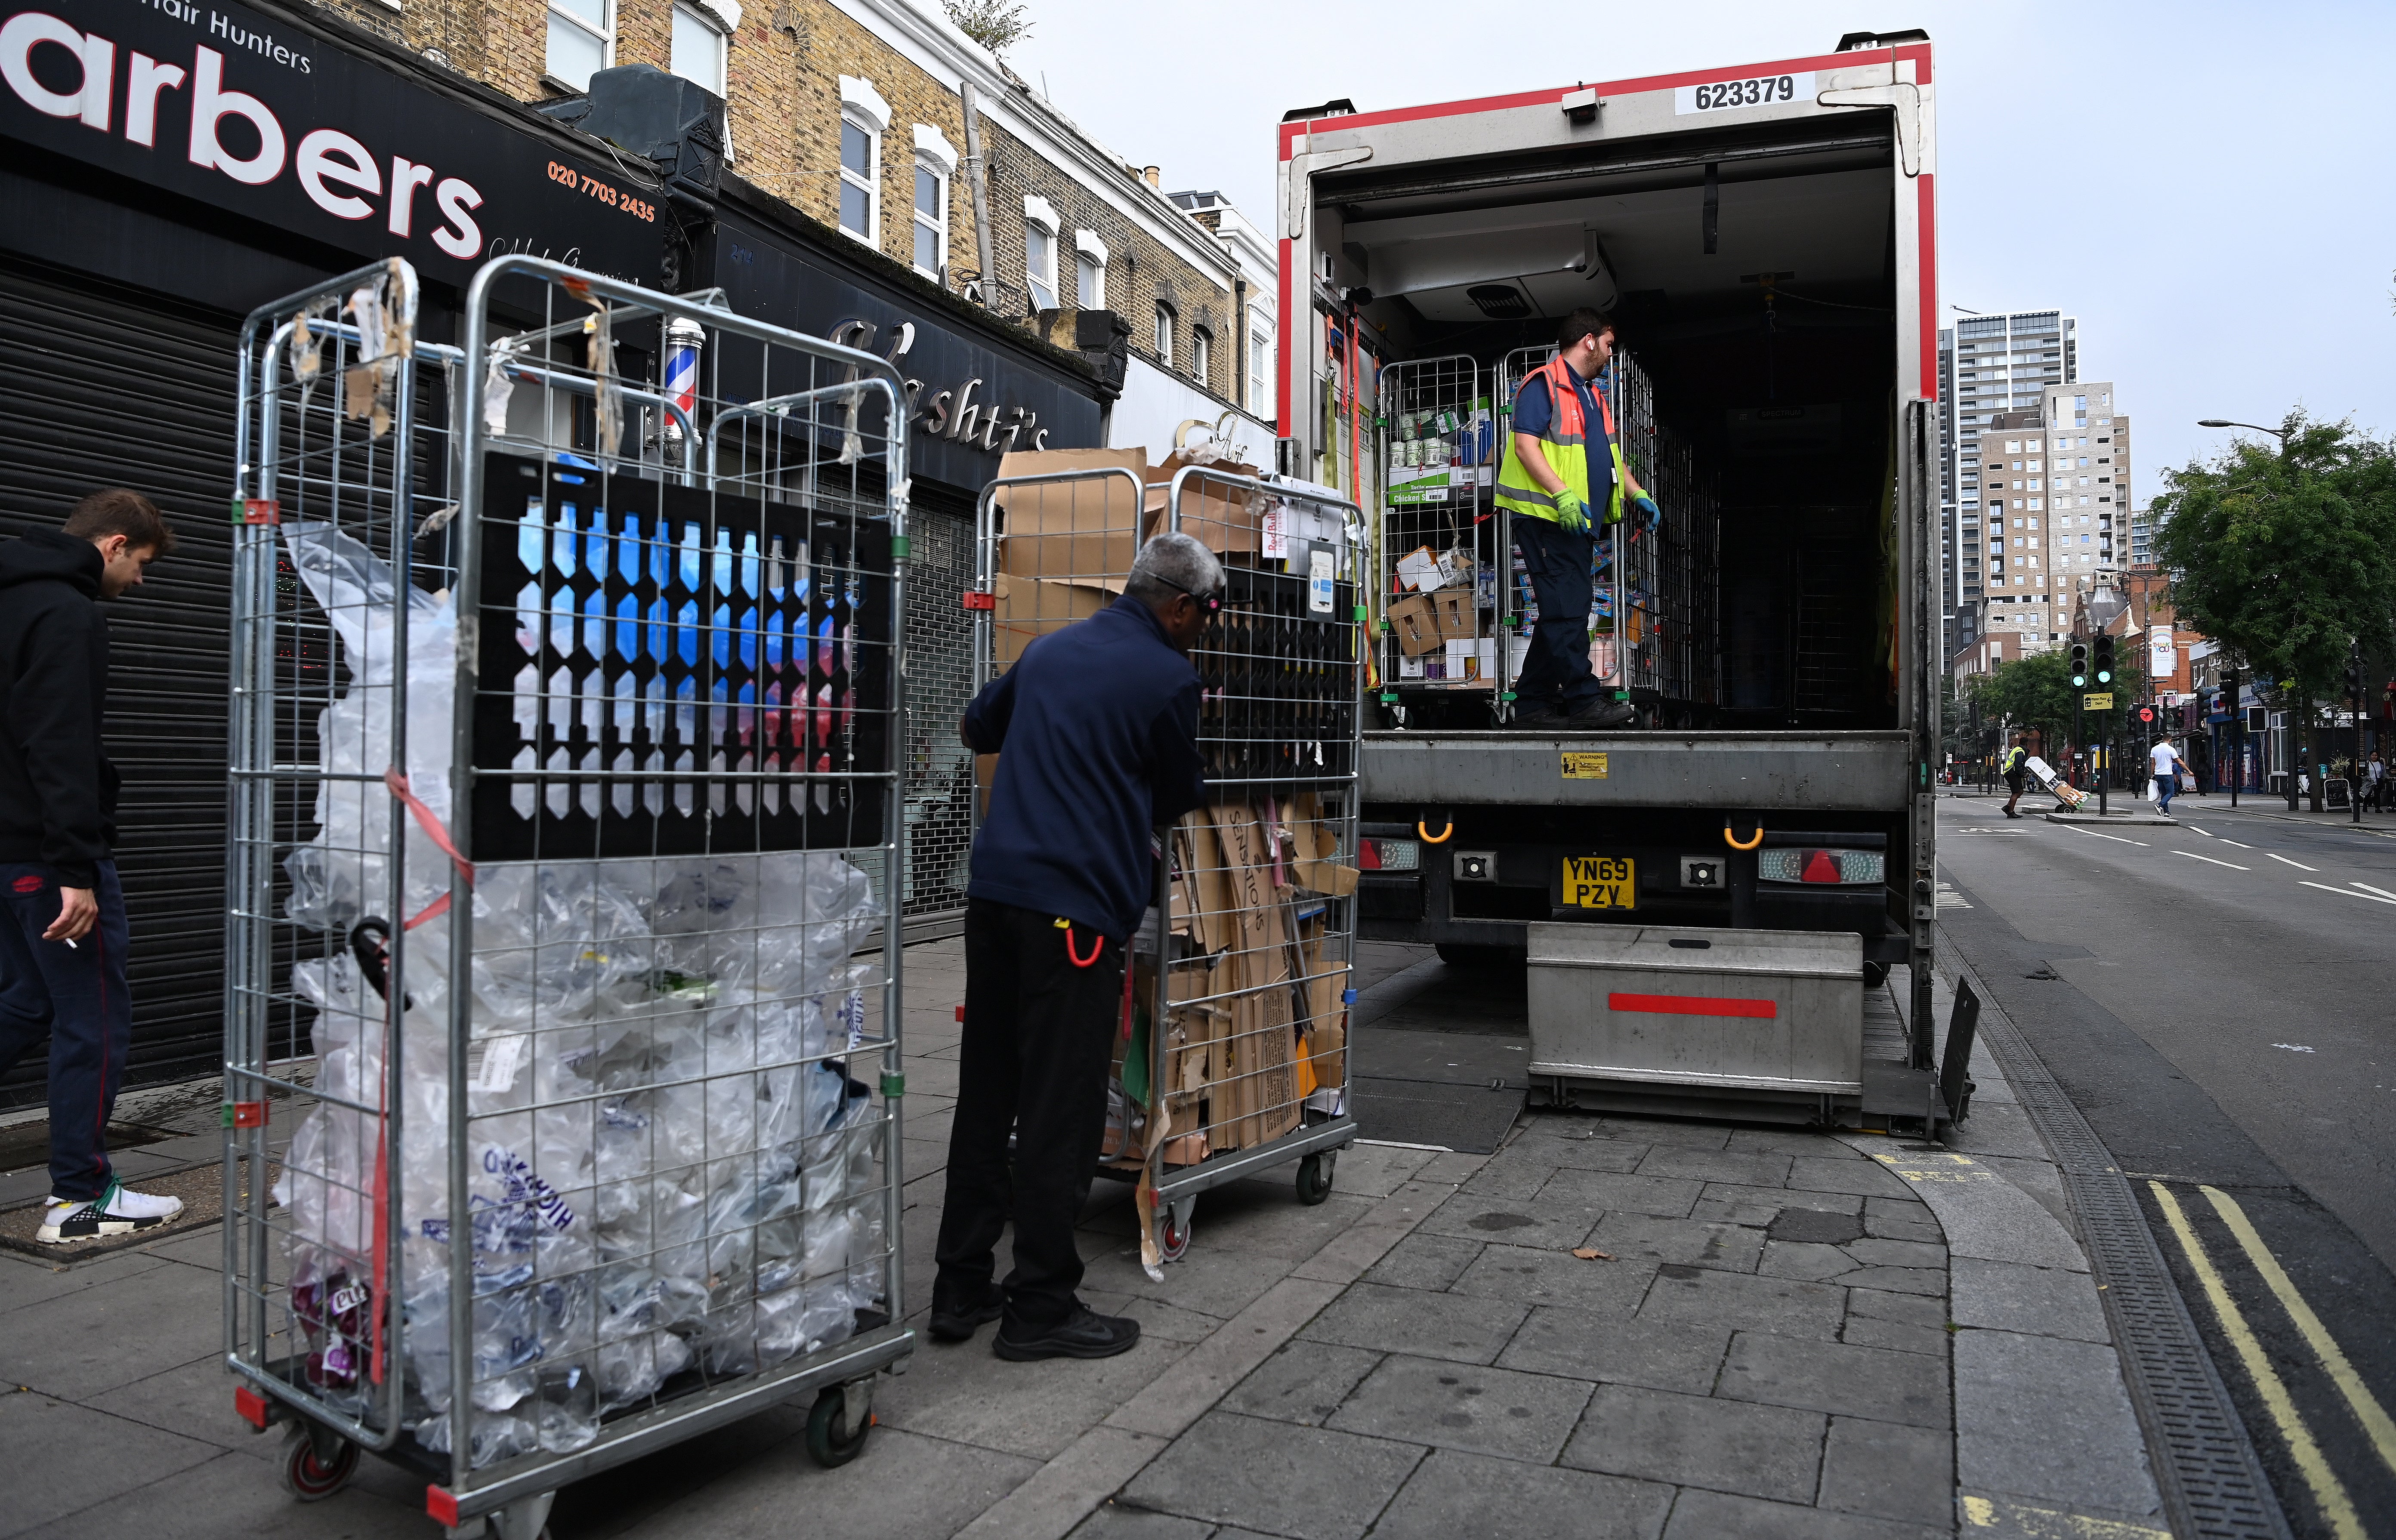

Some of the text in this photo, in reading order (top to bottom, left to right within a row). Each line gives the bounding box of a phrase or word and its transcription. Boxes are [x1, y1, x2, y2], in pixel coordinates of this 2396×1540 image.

[142, 0, 311, 74] air Hunters
[1696, 76, 1793, 110] 623379
[0, 11, 485, 260] arbers
[548, 161, 655, 222] 020 7703 2435
[731, 243, 753, 266] 214
[1394, 494, 1420, 503] Chicken
[1229, 810, 1265, 931] SENSATIONS
[1569, 860, 1628, 881] YN69
[1576, 885, 1621, 904] PZV
